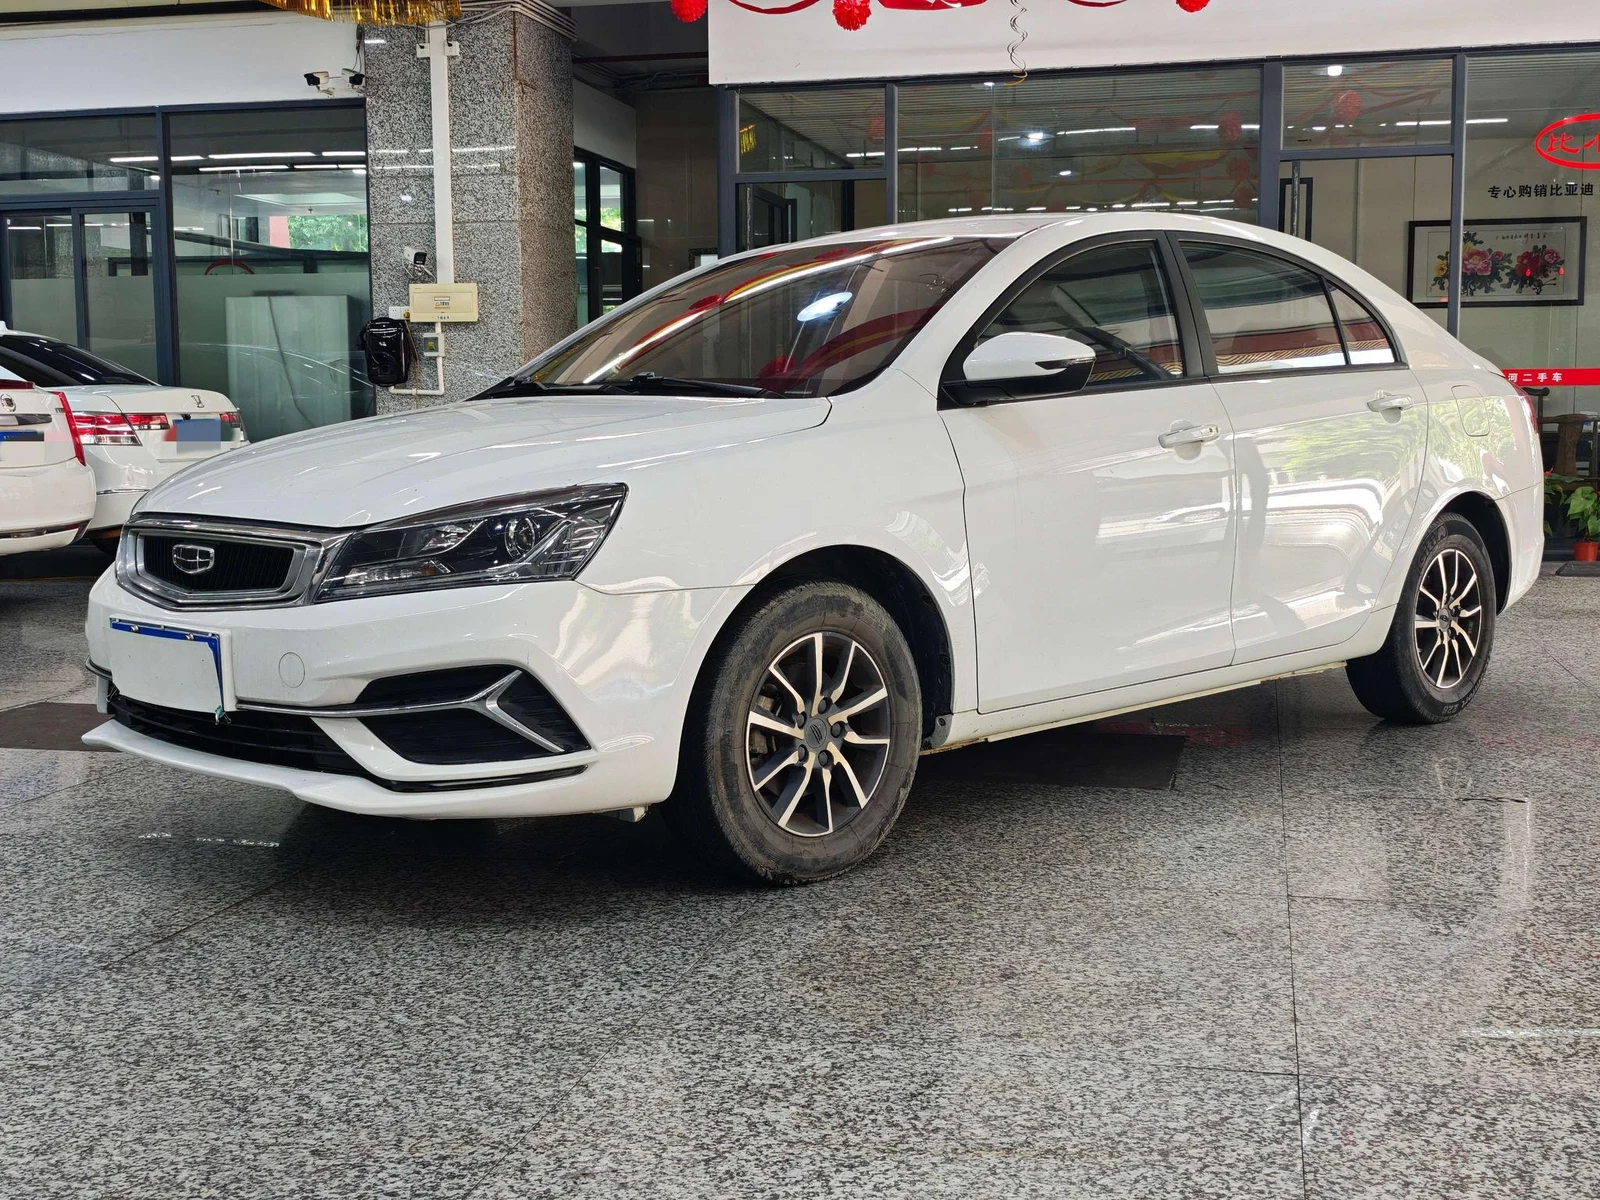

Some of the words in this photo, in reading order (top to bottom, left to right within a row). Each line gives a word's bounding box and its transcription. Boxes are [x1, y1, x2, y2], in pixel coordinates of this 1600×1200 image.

[1487, 182, 1594, 199] 专心购销比亚迪
[1507, 372, 1563, 383] 河二手车
